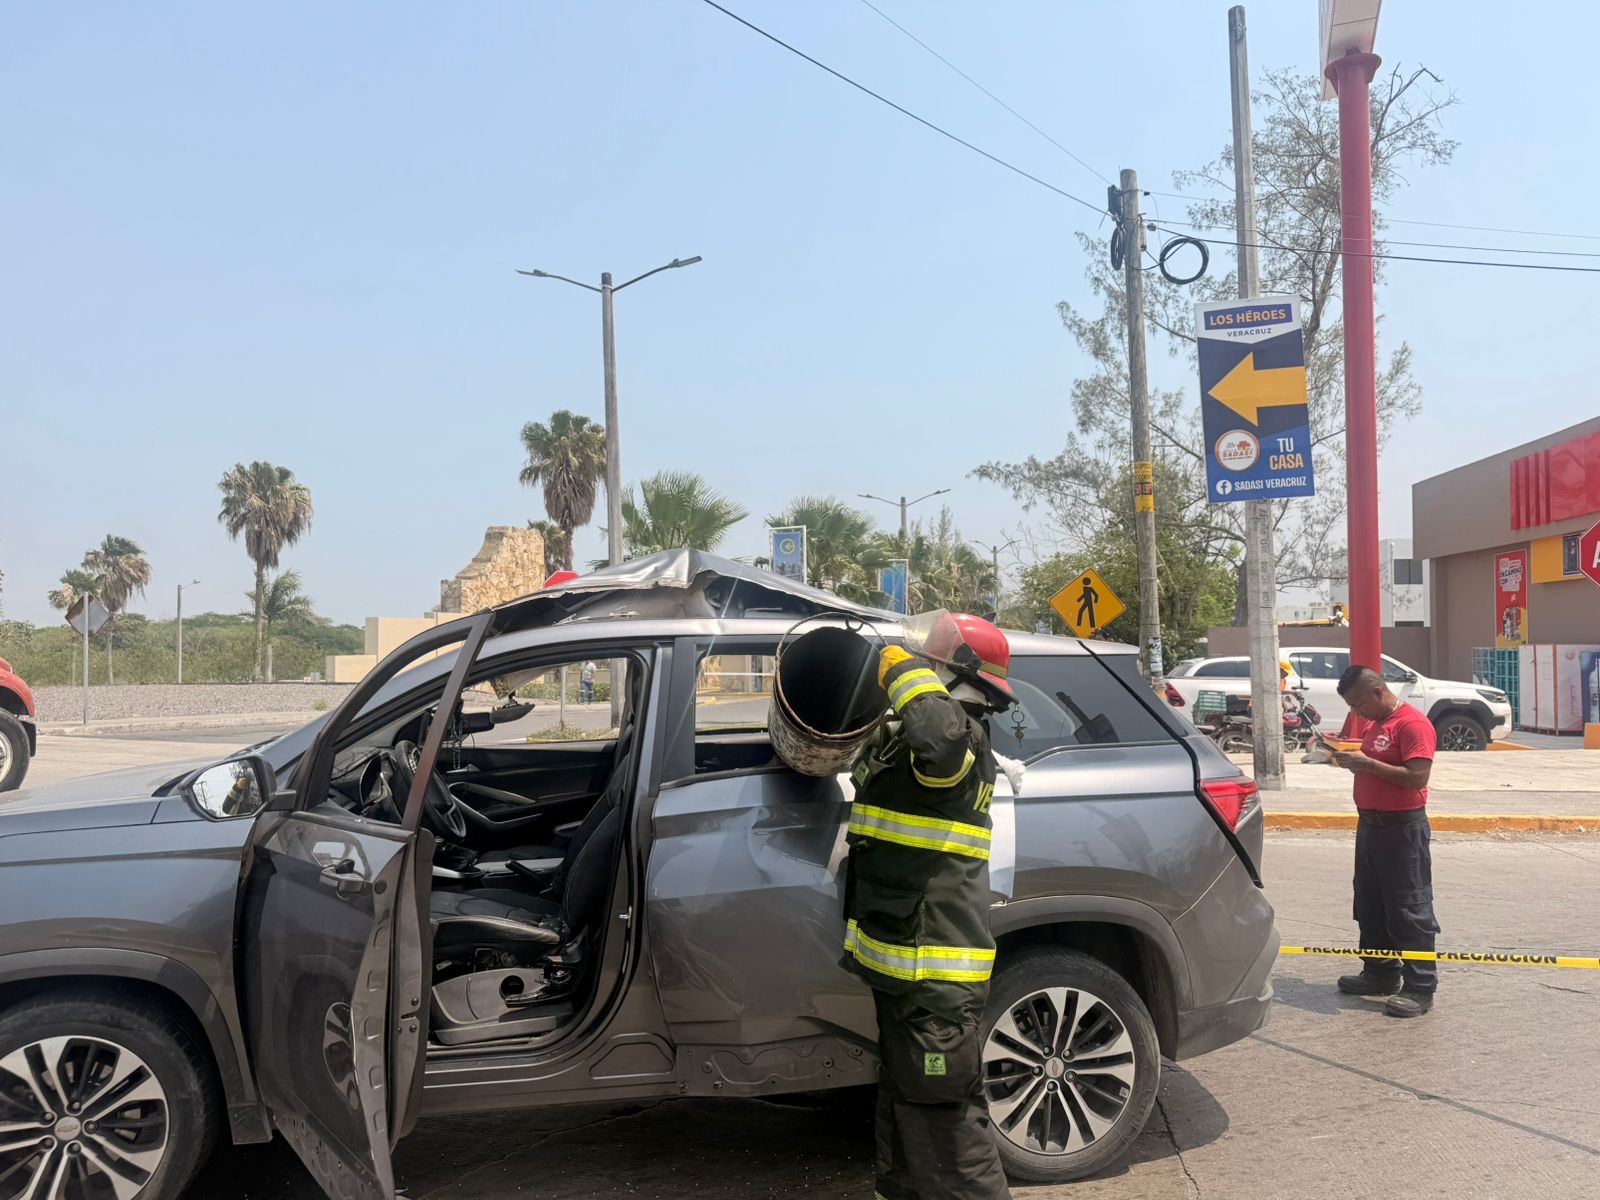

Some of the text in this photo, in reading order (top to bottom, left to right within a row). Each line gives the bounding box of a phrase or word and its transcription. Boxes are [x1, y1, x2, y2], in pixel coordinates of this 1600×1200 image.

[1210, 309, 1287, 326] LOS HÉROES
[1227, 328, 1272, 338] VERACRUZ
[1277, 437, 1295, 453] TU
[1269, 453, 1304, 470] CASA
[1234, 480, 1264, 491] SADASI
[1265, 476, 1307, 488] VERACRUZ
